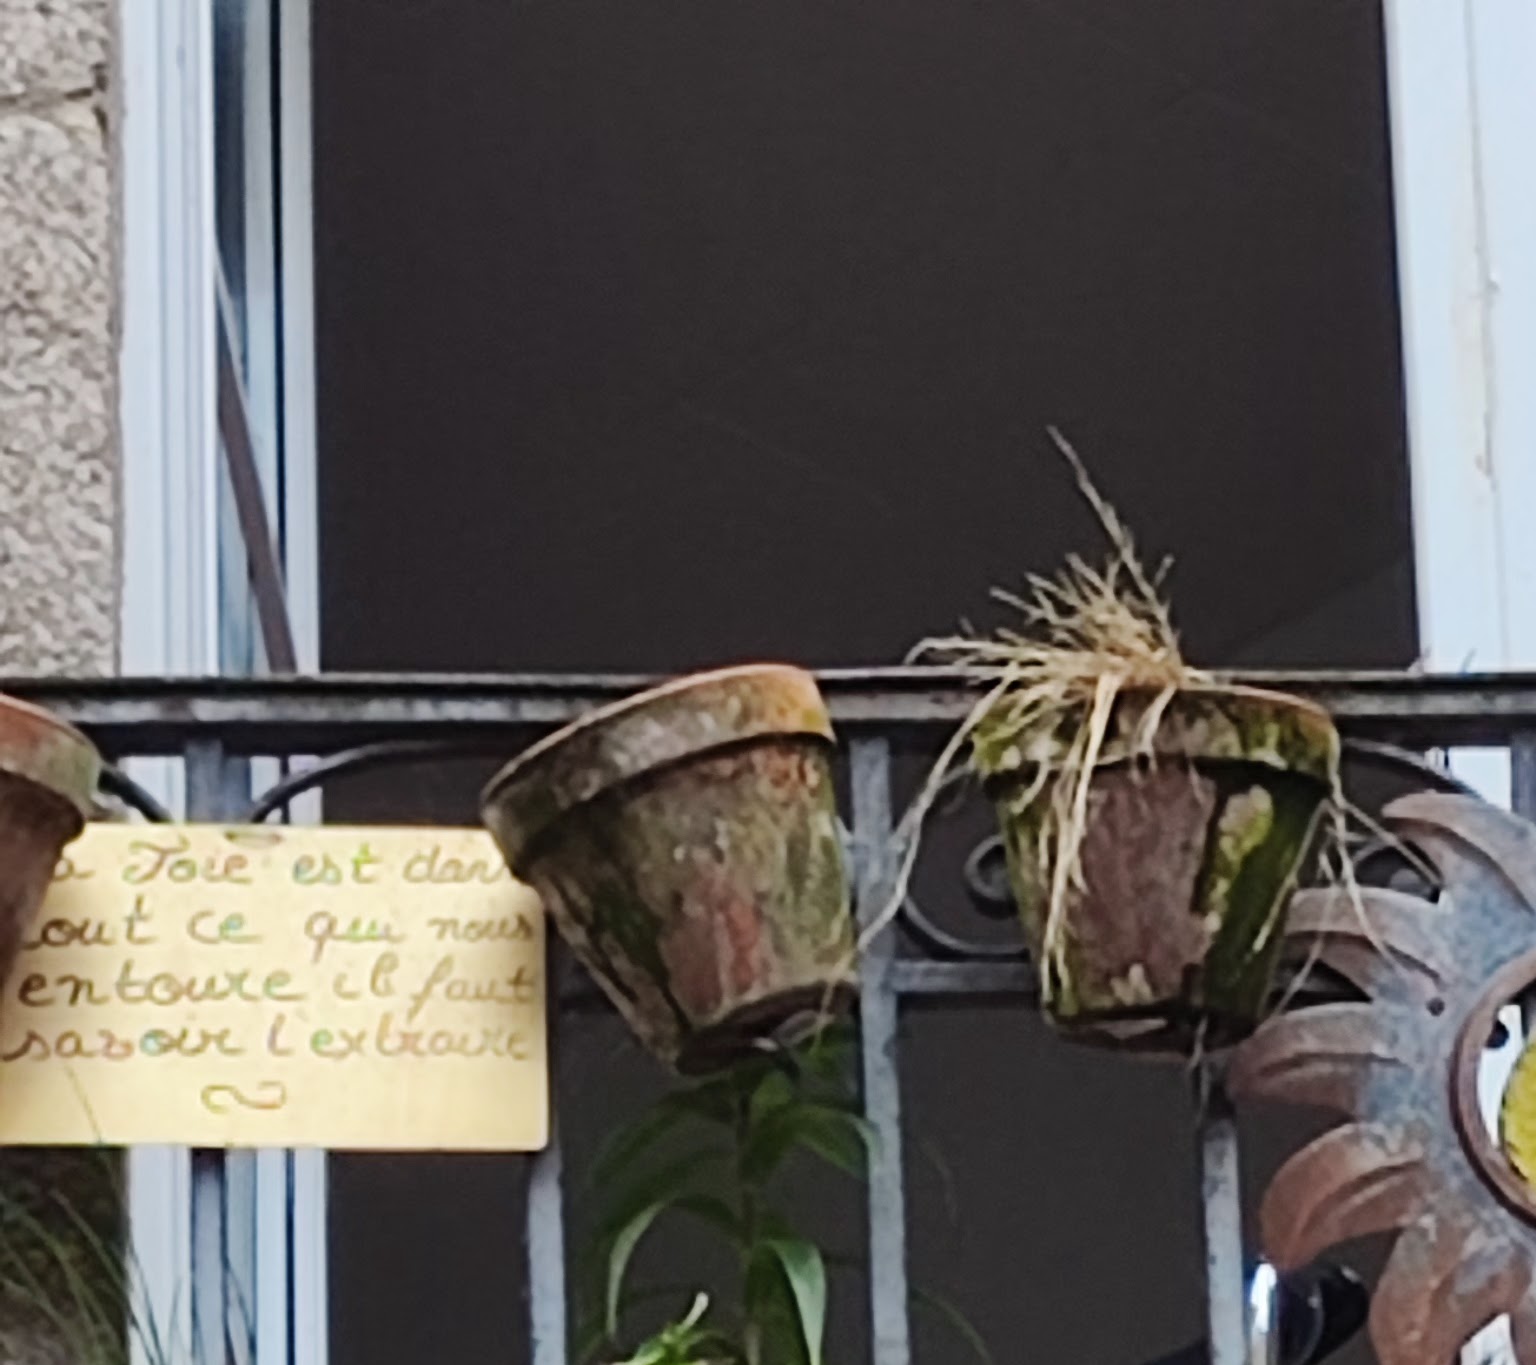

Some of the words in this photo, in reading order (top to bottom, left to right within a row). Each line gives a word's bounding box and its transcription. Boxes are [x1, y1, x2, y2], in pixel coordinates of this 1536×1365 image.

[52, 856, 95, 881] a
[122, 835, 252, 884] Joie
[292, 843, 381, 885] est
[402, 845, 507, 884] dan
[22, 893, 158, 950] out
[187, 909, 262, 944] ce
[304, 910, 406, 964] qui
[427, 909, 534, 940] nous
[18, 958, 306, 1007] entoure
[333, 953, 399, 1000] il
[409, 958, 536, 1022] faut
[2, 1026, 246, 1062] savoir
